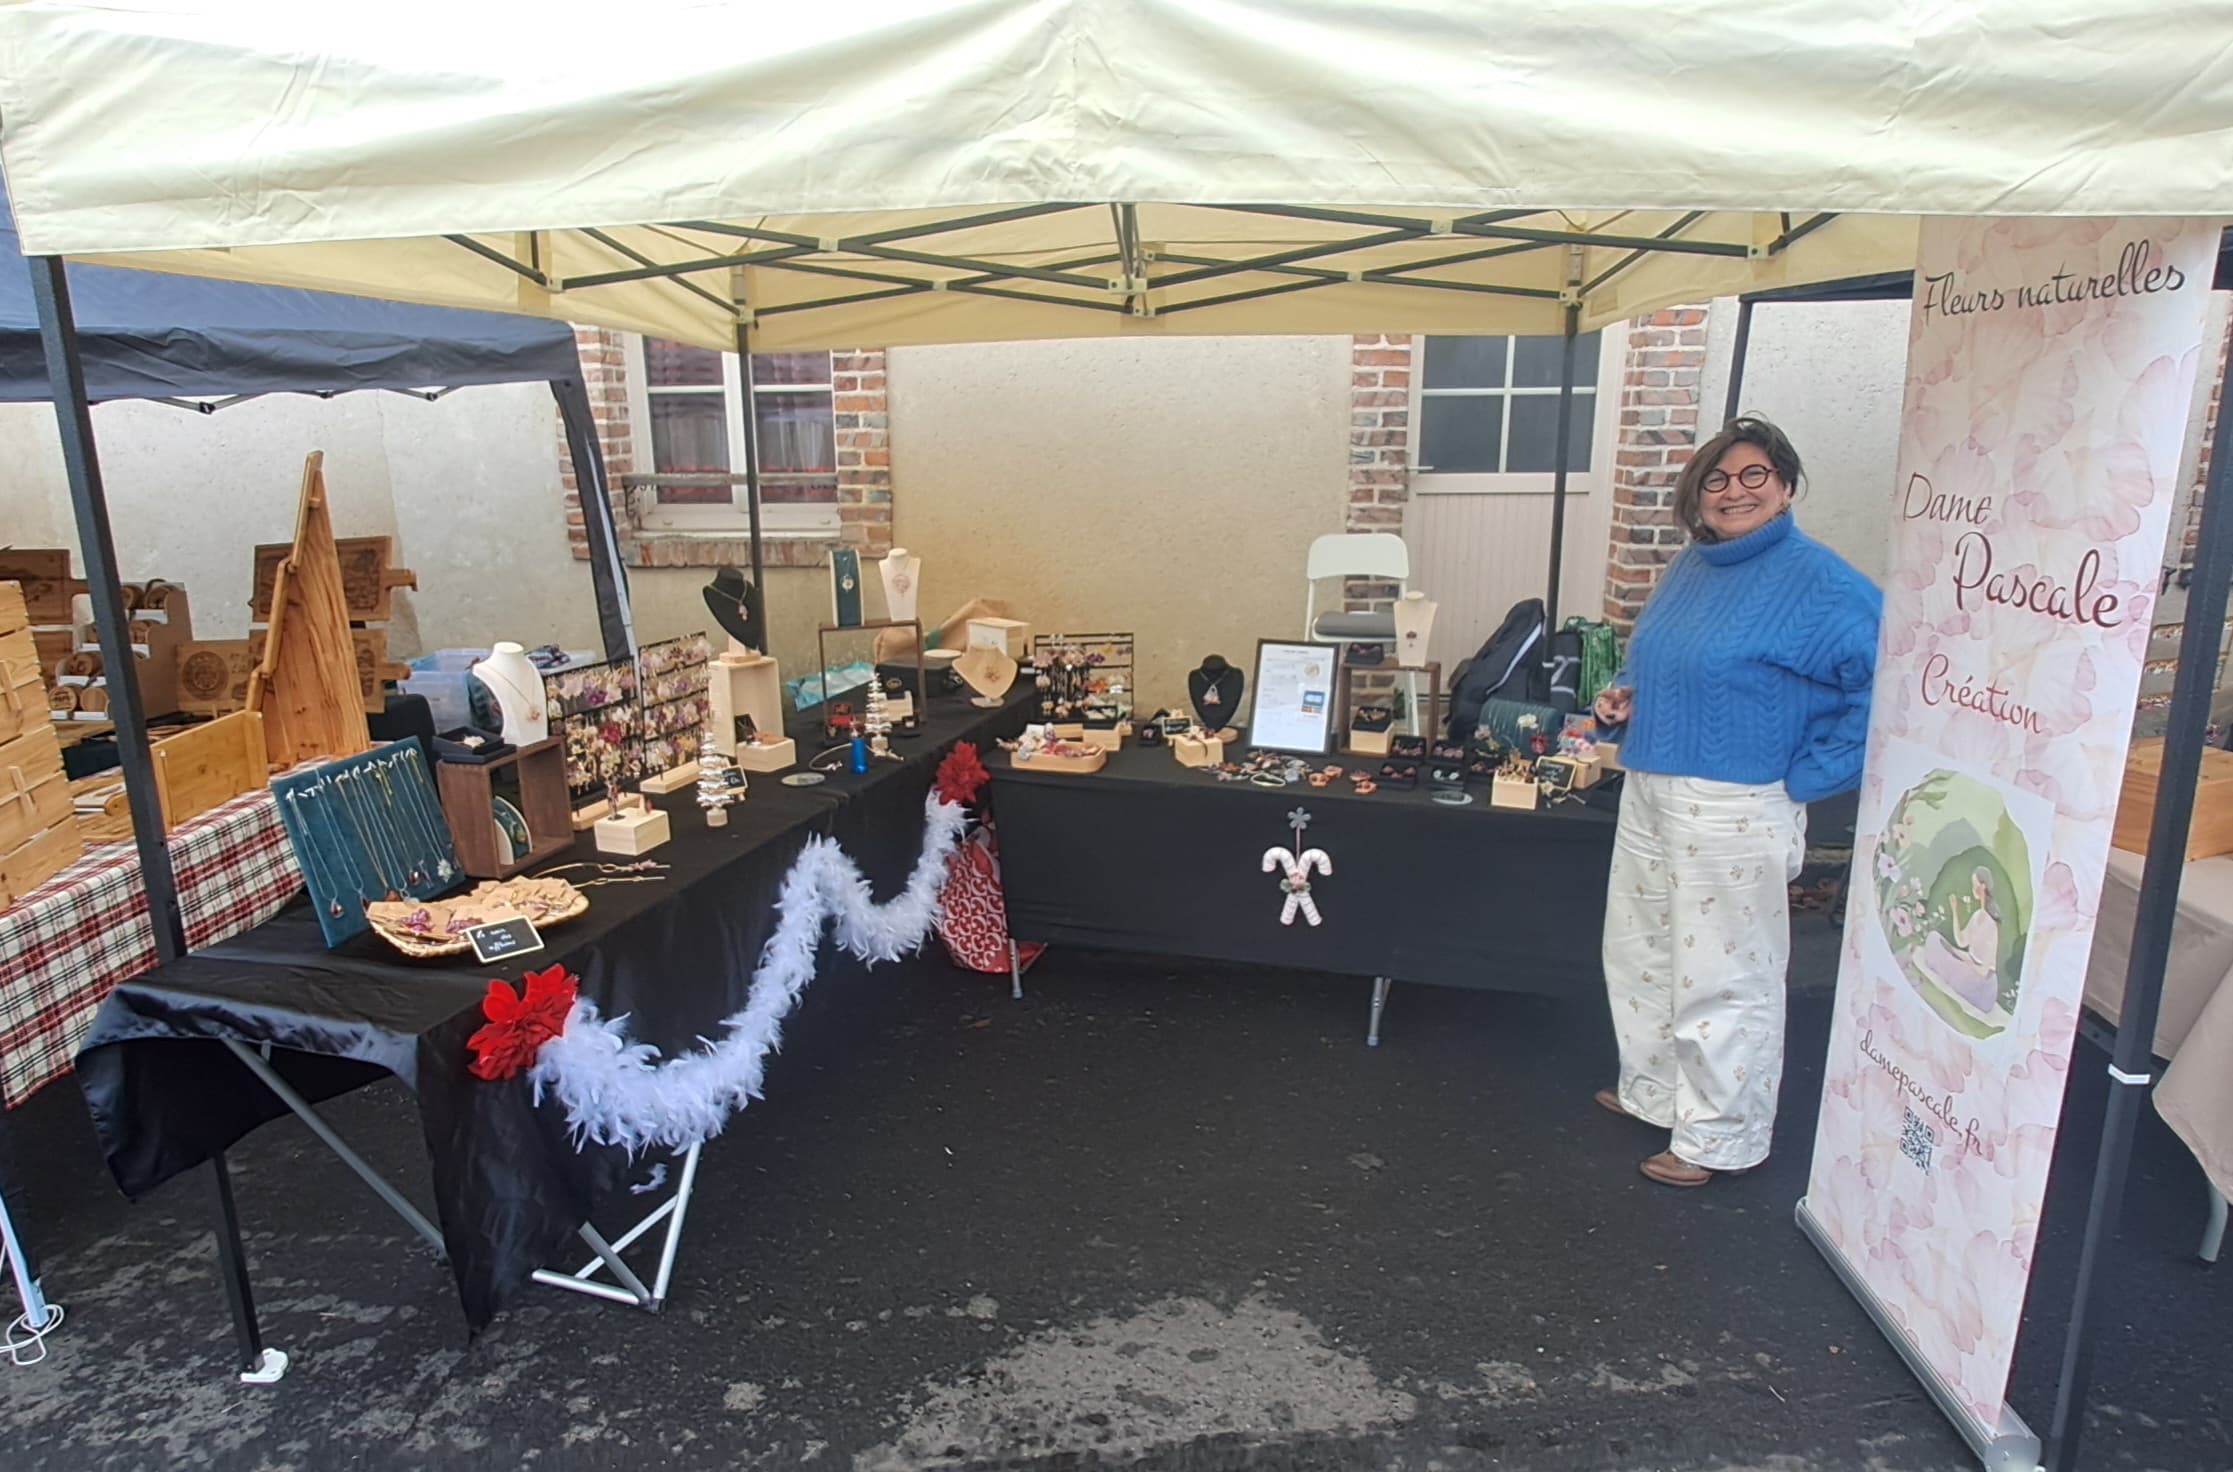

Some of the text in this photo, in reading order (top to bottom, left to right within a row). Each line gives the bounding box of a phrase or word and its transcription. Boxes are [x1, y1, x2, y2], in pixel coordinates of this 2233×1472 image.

[1923, 239, 2186, 326] Fleurs naturelles
[1903, 471, 1993, 525] Dame
[1952, 531, 2122, 628] Pascale
[1921, 653, 2041, 734] Création
[1859, 1029, 1983, 1160] damepascale.fr
